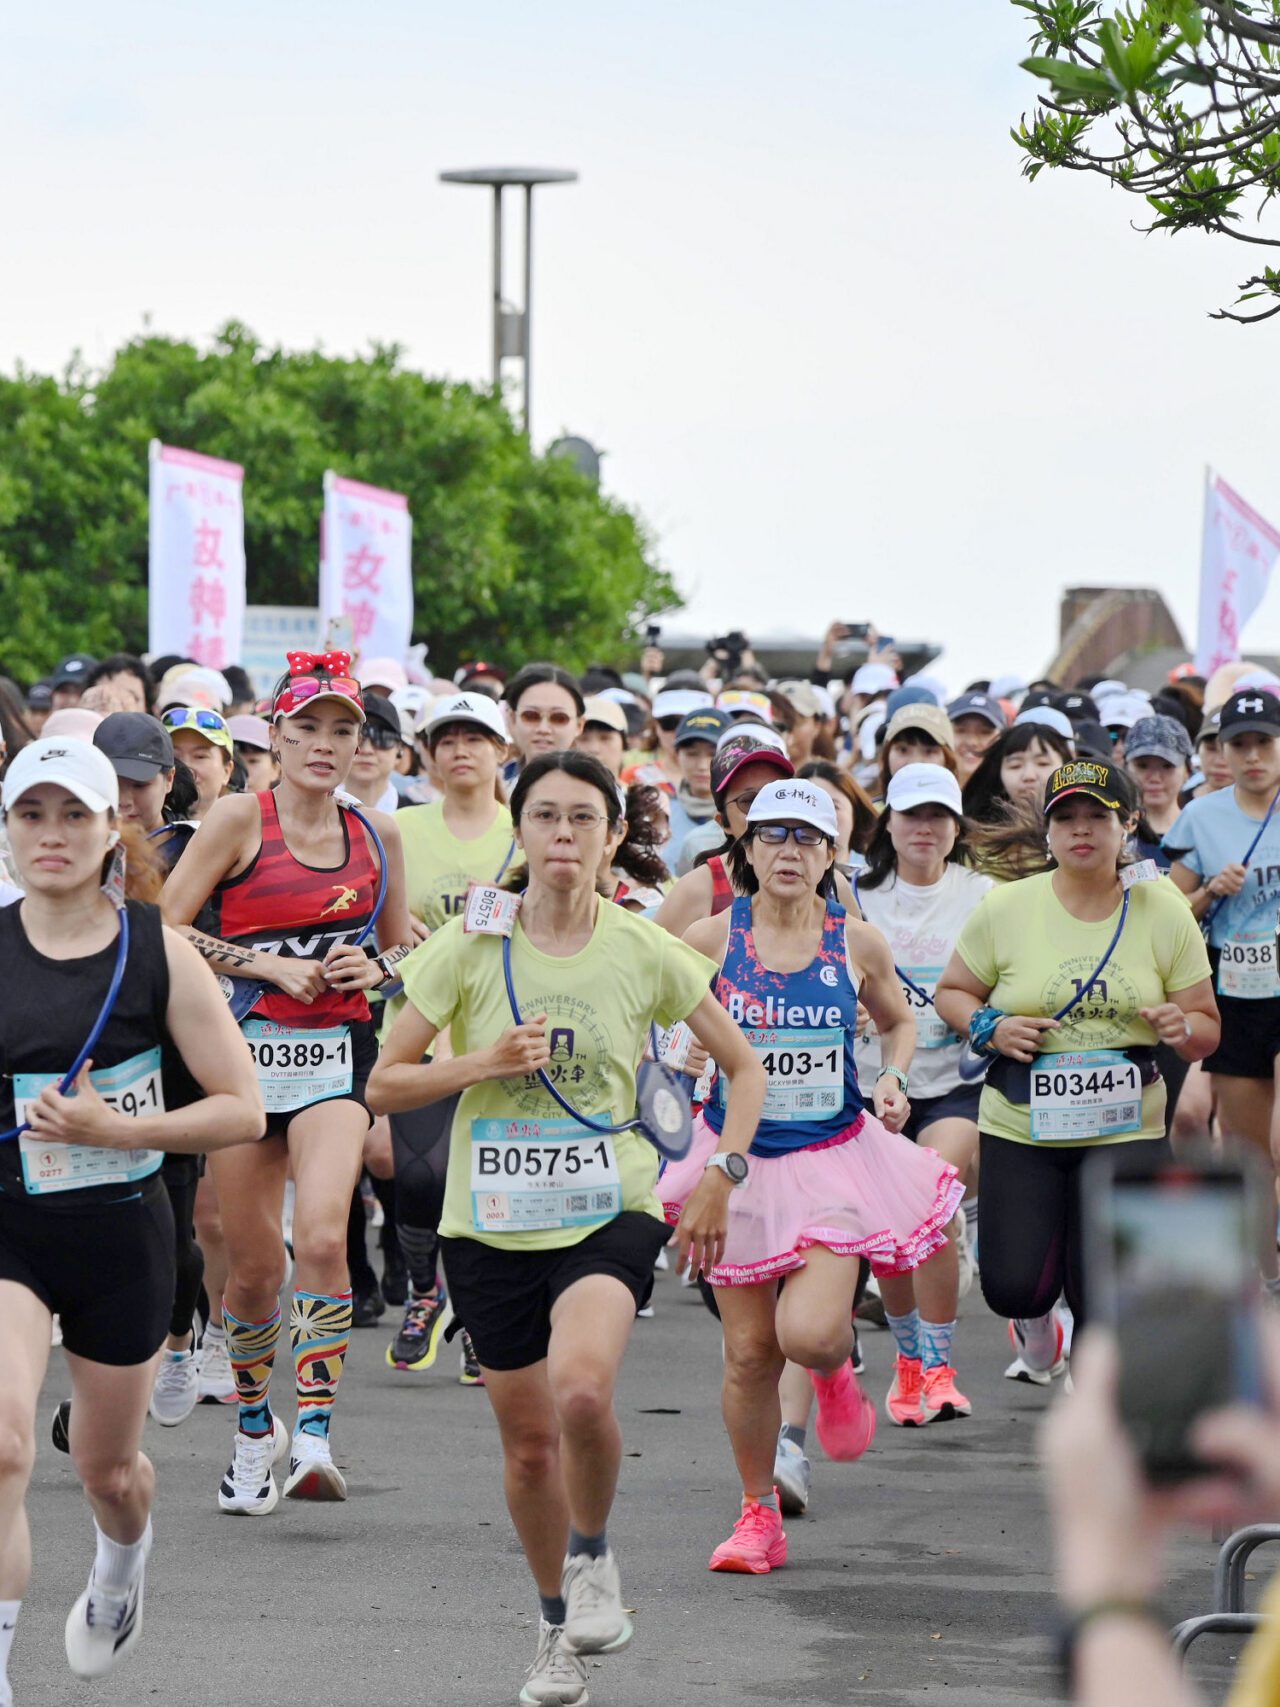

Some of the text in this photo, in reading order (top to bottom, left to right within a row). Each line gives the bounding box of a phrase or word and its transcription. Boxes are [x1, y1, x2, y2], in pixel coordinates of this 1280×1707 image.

[475, 890, 497, 926] B0575
[194, 944, 254, 967] VTT
[1058, 955, 1123, 972] ANNIVERARY
[1222, 944, 1277, 964] B038
[519, 994, 598, 1016] ANNIVERSARY
[729, 993, 841, 1026] Believe
[1035, 1067, 1137, 1097] B0344-1
[478, 1141, 610, 1176] B0575-1
[40, 1168, 63, 1178] 0277
